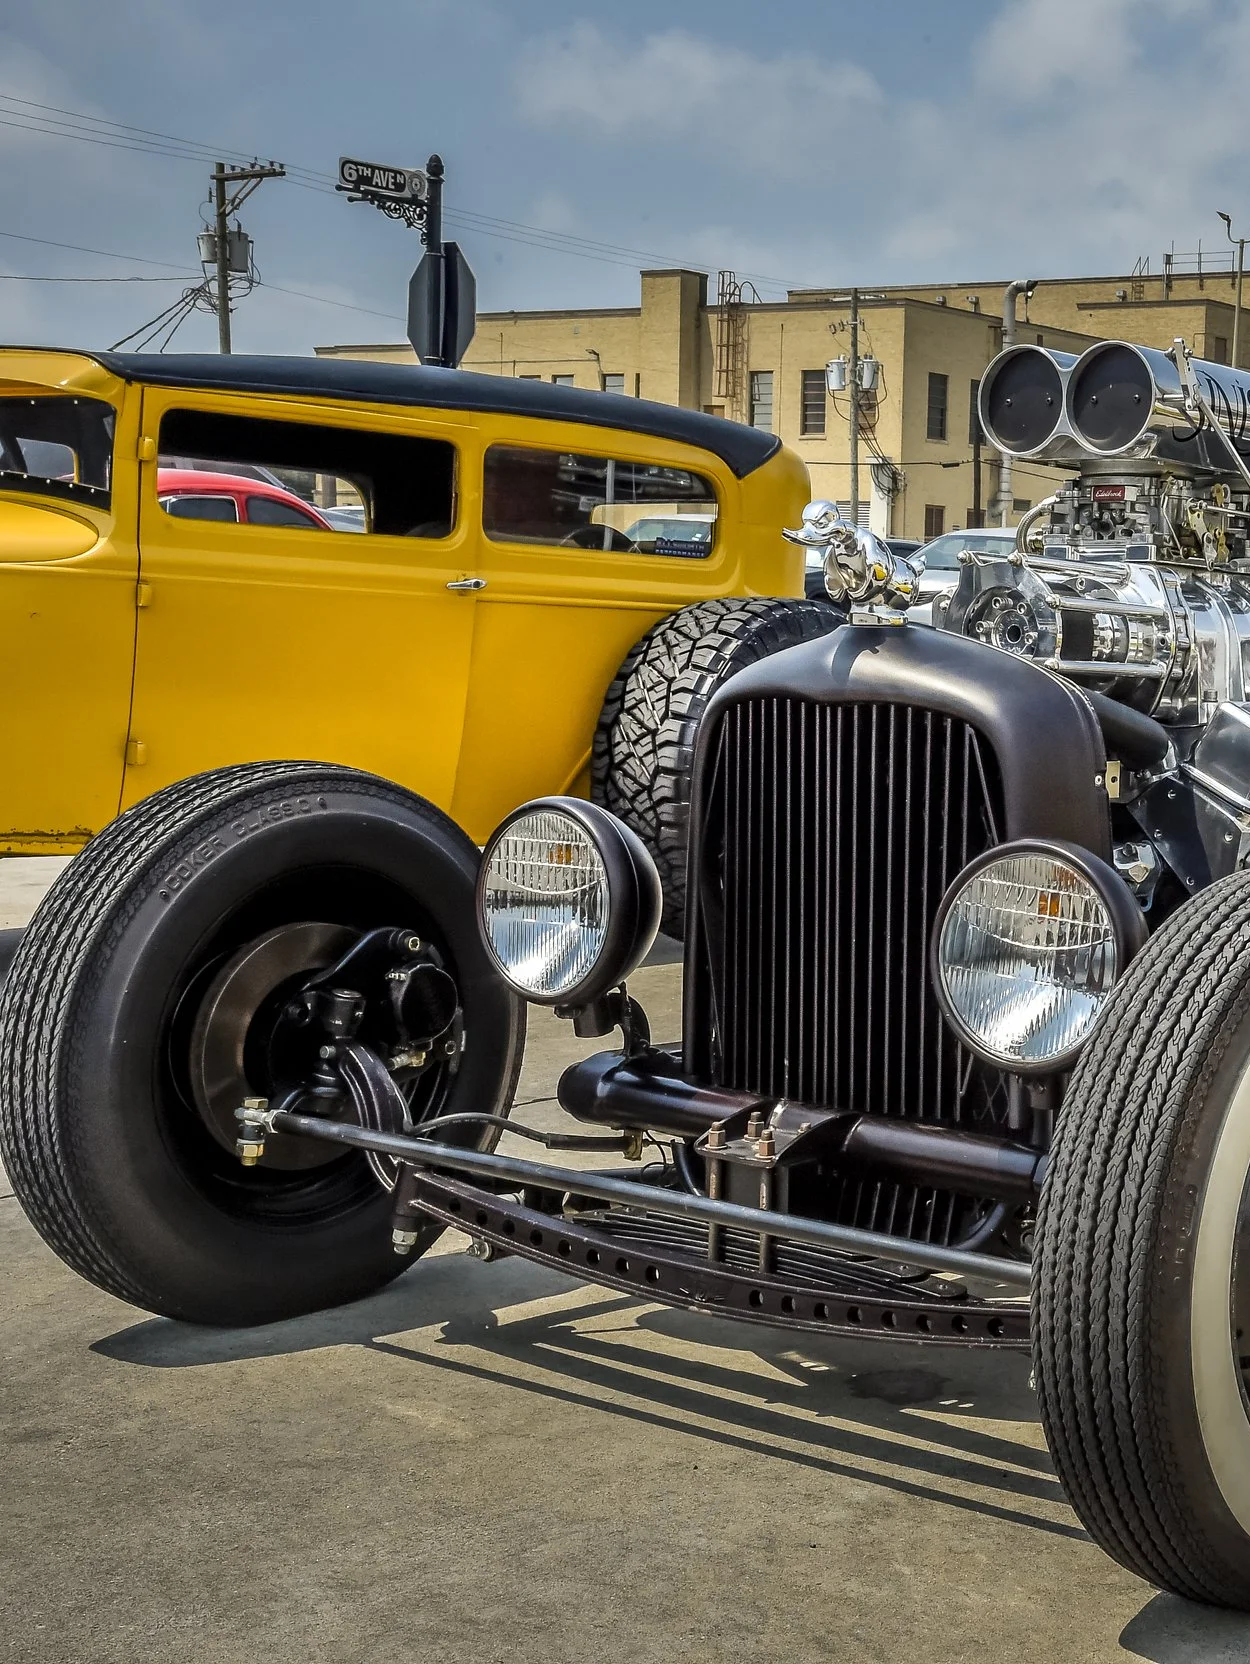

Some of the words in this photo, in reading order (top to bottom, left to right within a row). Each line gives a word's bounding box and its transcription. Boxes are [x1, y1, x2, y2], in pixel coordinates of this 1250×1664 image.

[343, 163, 371, 181] 6TH
[372, 169, 395, 189] AVE
[396, 173, 405, 184] N
[164, 834, 228, 891] COKER
